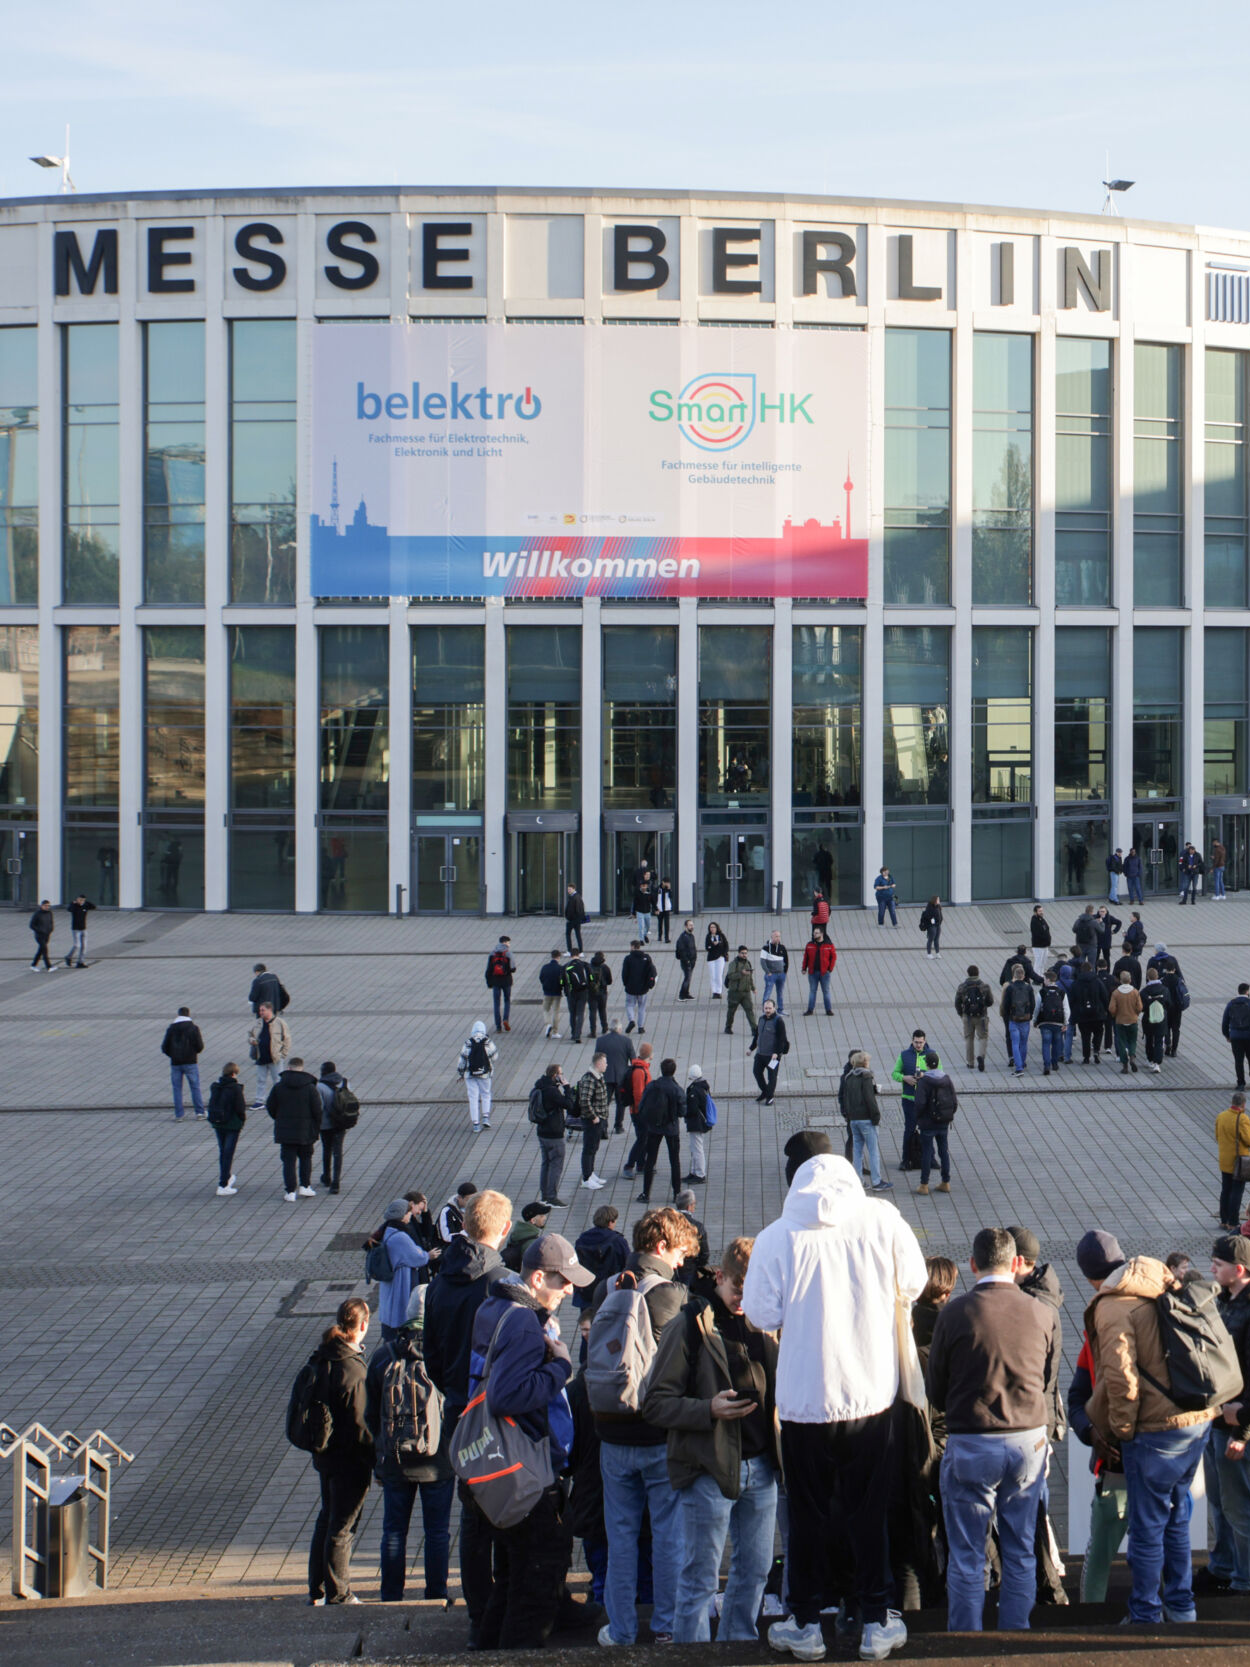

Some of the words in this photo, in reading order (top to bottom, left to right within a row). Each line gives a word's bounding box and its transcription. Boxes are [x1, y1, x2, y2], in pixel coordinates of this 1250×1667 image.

[53, 221, 475, 296] MESSE
[613, 223, 1112, 312] BERLIN
[356, 381, 542, 421] belektro
[368, 433, 426, 444] Fachmesse
[428, 433, 445, 444] für
[447, 433, 529, 446] Elektrotechnik,
[394, 447, 449, 458] Elektronik
[452, 447, 474, 458] und
[476, 447, 503, 458] Licht
[661, 460, 719, 471] Fachmesse
[722, 460, 738, 471] für
[740, 461, 803, 474] intelligente
[688, 474, 776, 485] Gebäudetechnik
[482, 550, 701, 579] Willkommen
[457, 1426, 495, 1468] PUMA
